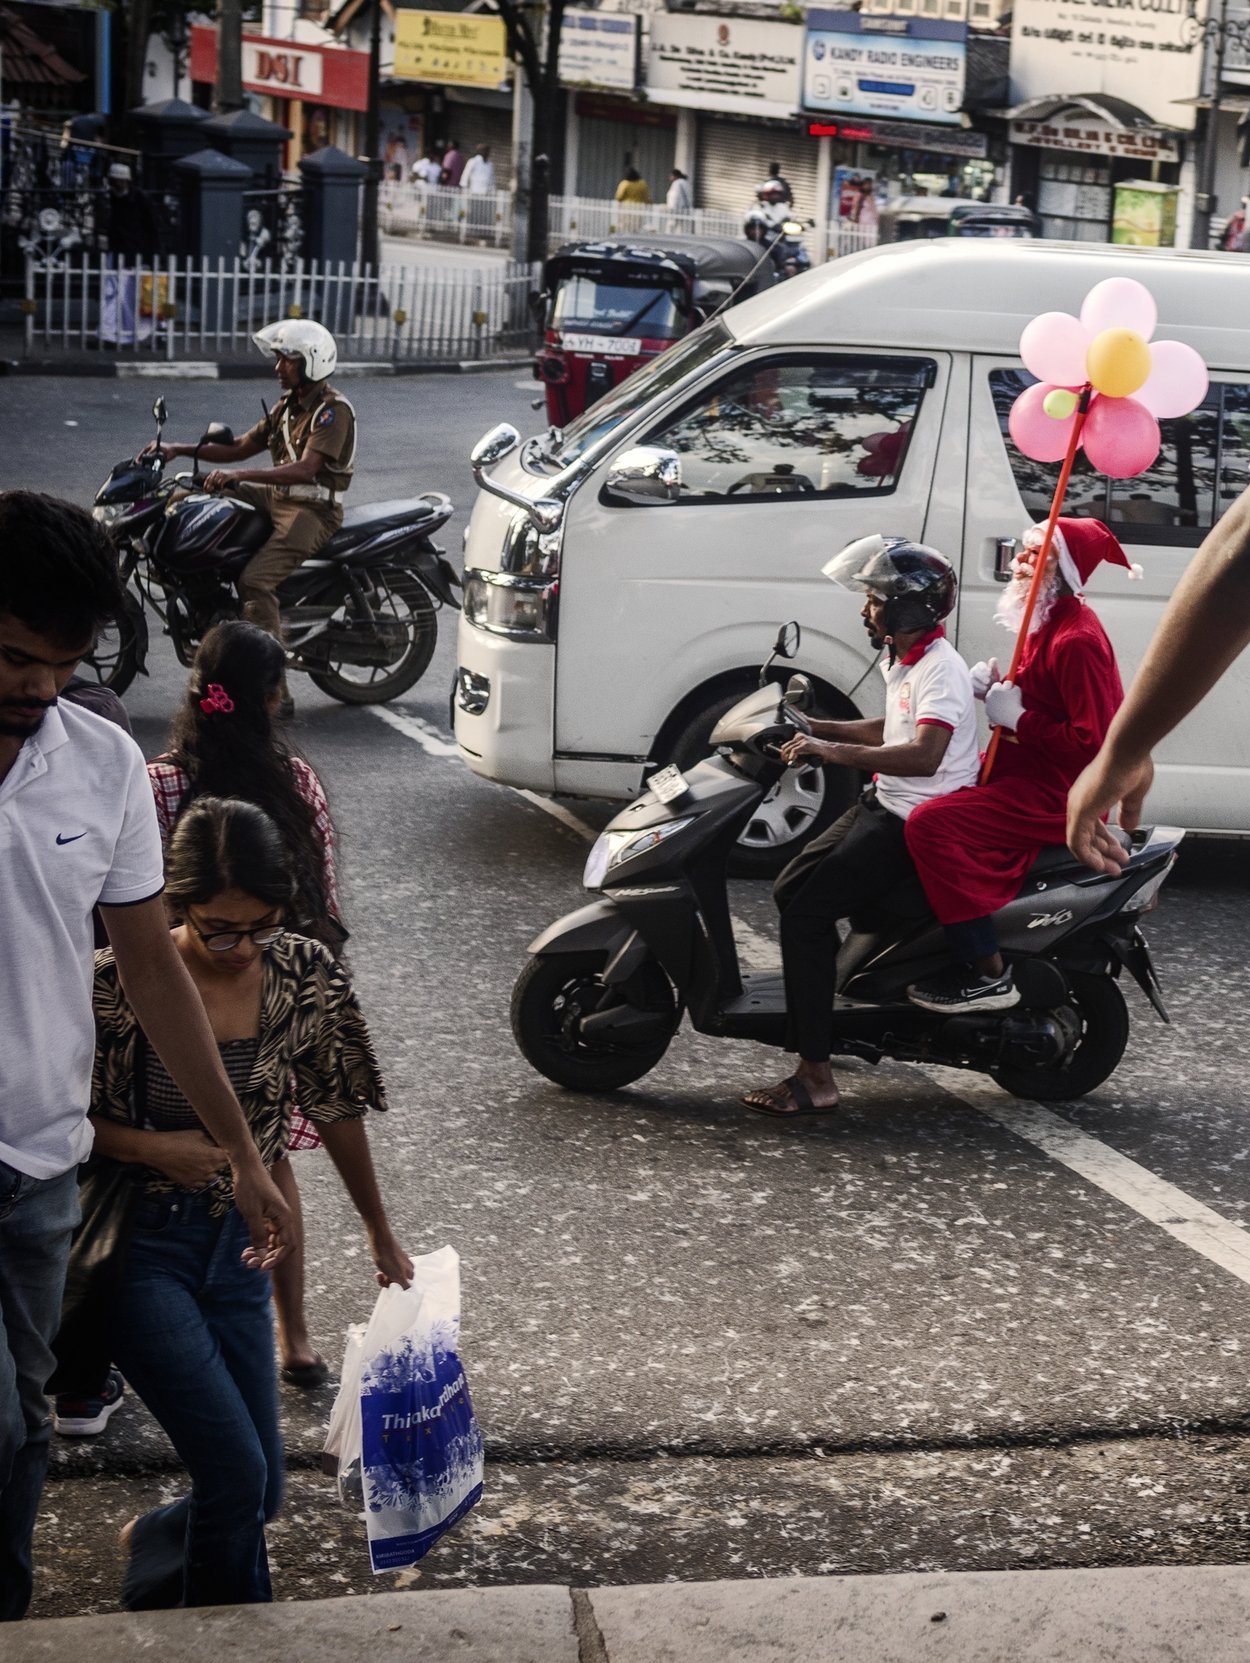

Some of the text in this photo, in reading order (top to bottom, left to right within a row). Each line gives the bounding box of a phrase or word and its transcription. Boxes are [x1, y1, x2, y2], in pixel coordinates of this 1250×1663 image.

[255, 50, 303, 87] DSI
[831, 47, 960, 71] KANDY RADIO ENGINEERS
